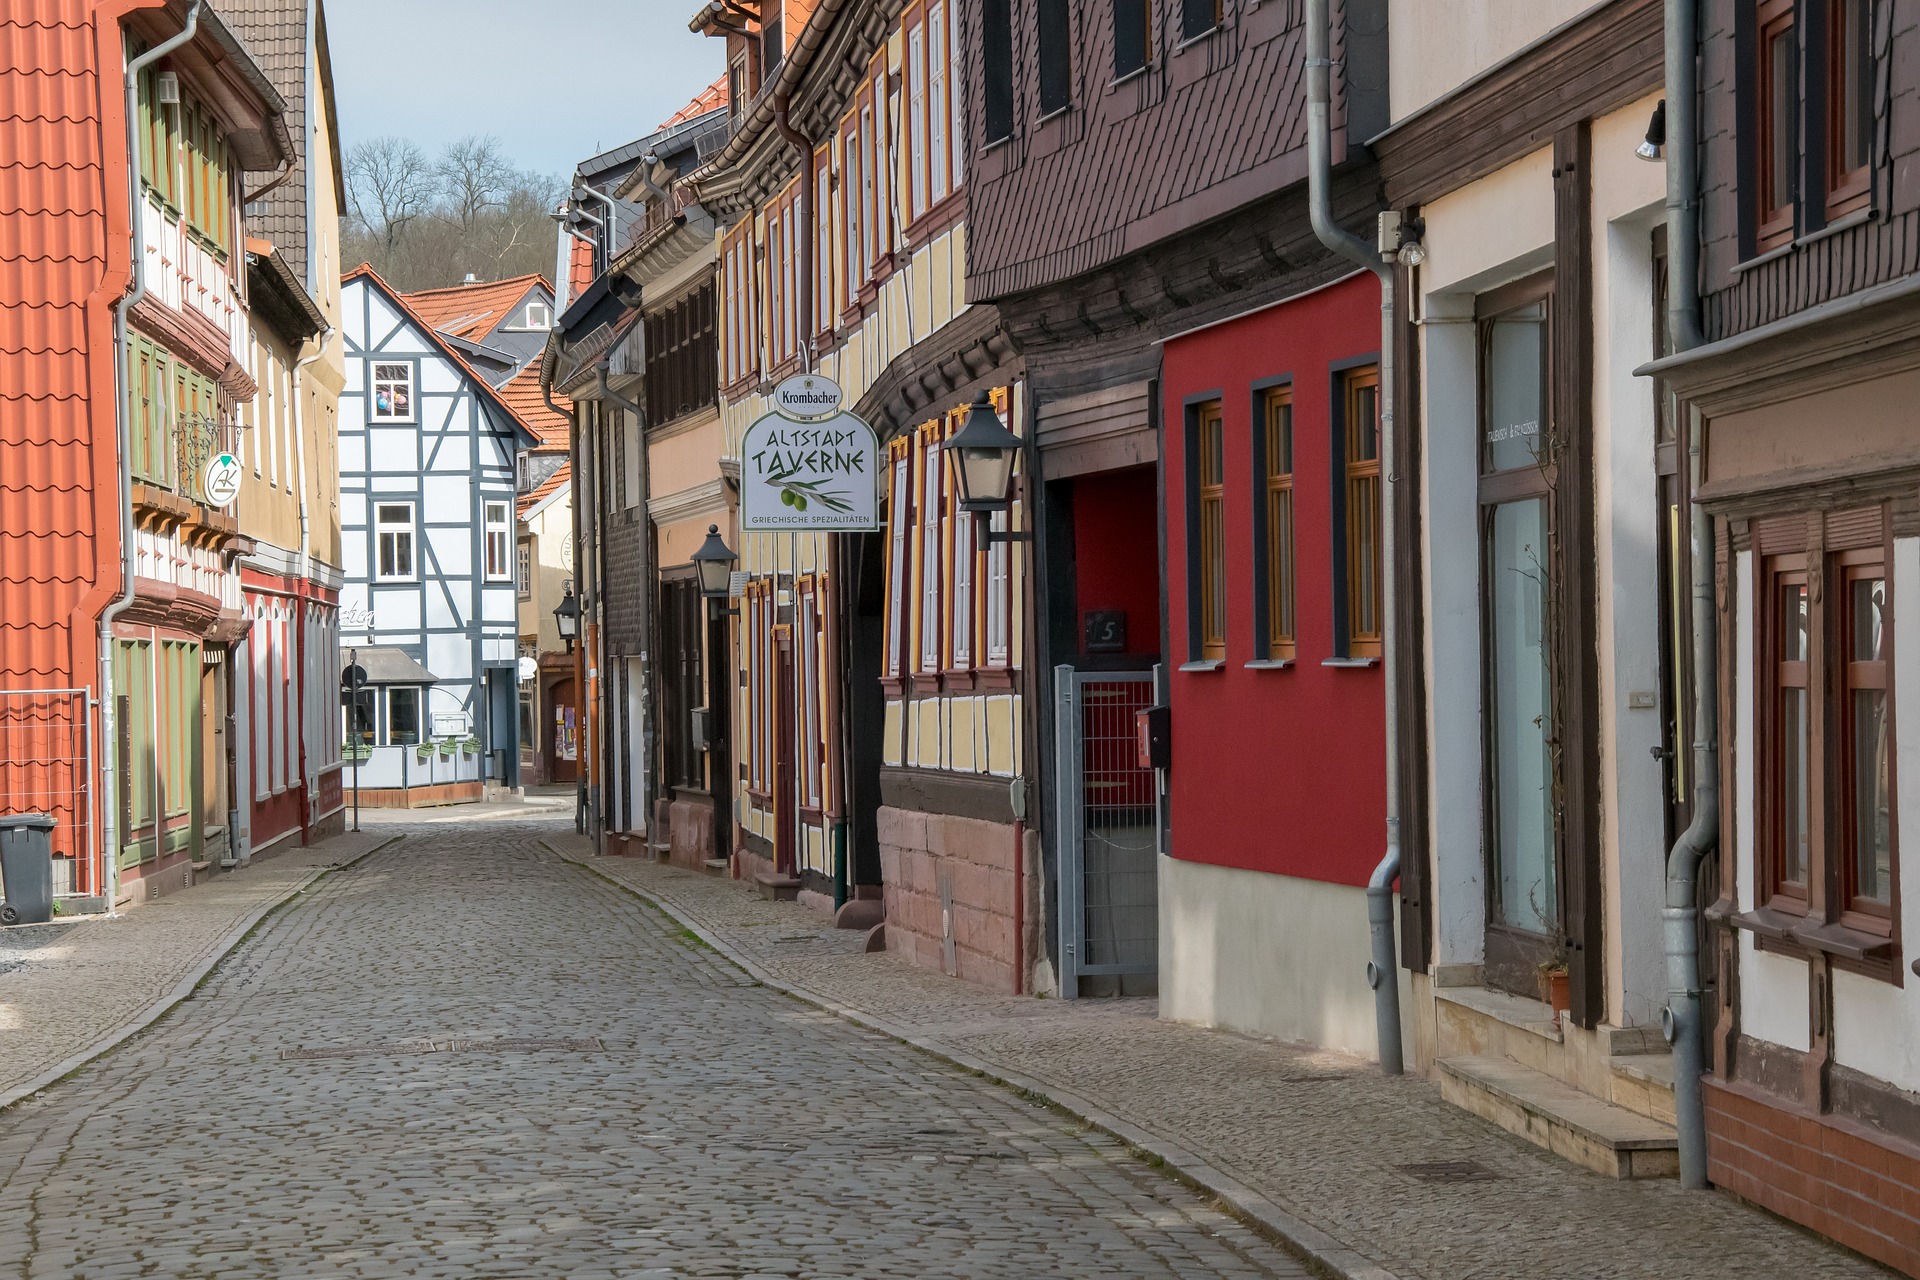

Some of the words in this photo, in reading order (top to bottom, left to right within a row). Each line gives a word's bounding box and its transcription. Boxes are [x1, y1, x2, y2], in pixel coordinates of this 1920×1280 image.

[782, 390, 838, 404] Krombacher
[766, 429, 856, 447] ALTSTADT
[751, 447, 864, 476] TAVERNE
[751, 515, 809, 524] GRIECHISCHE
[811, 514, 870, 524] SPEZIALITÄTEN
[1101, 621, 1116, 641] 5
